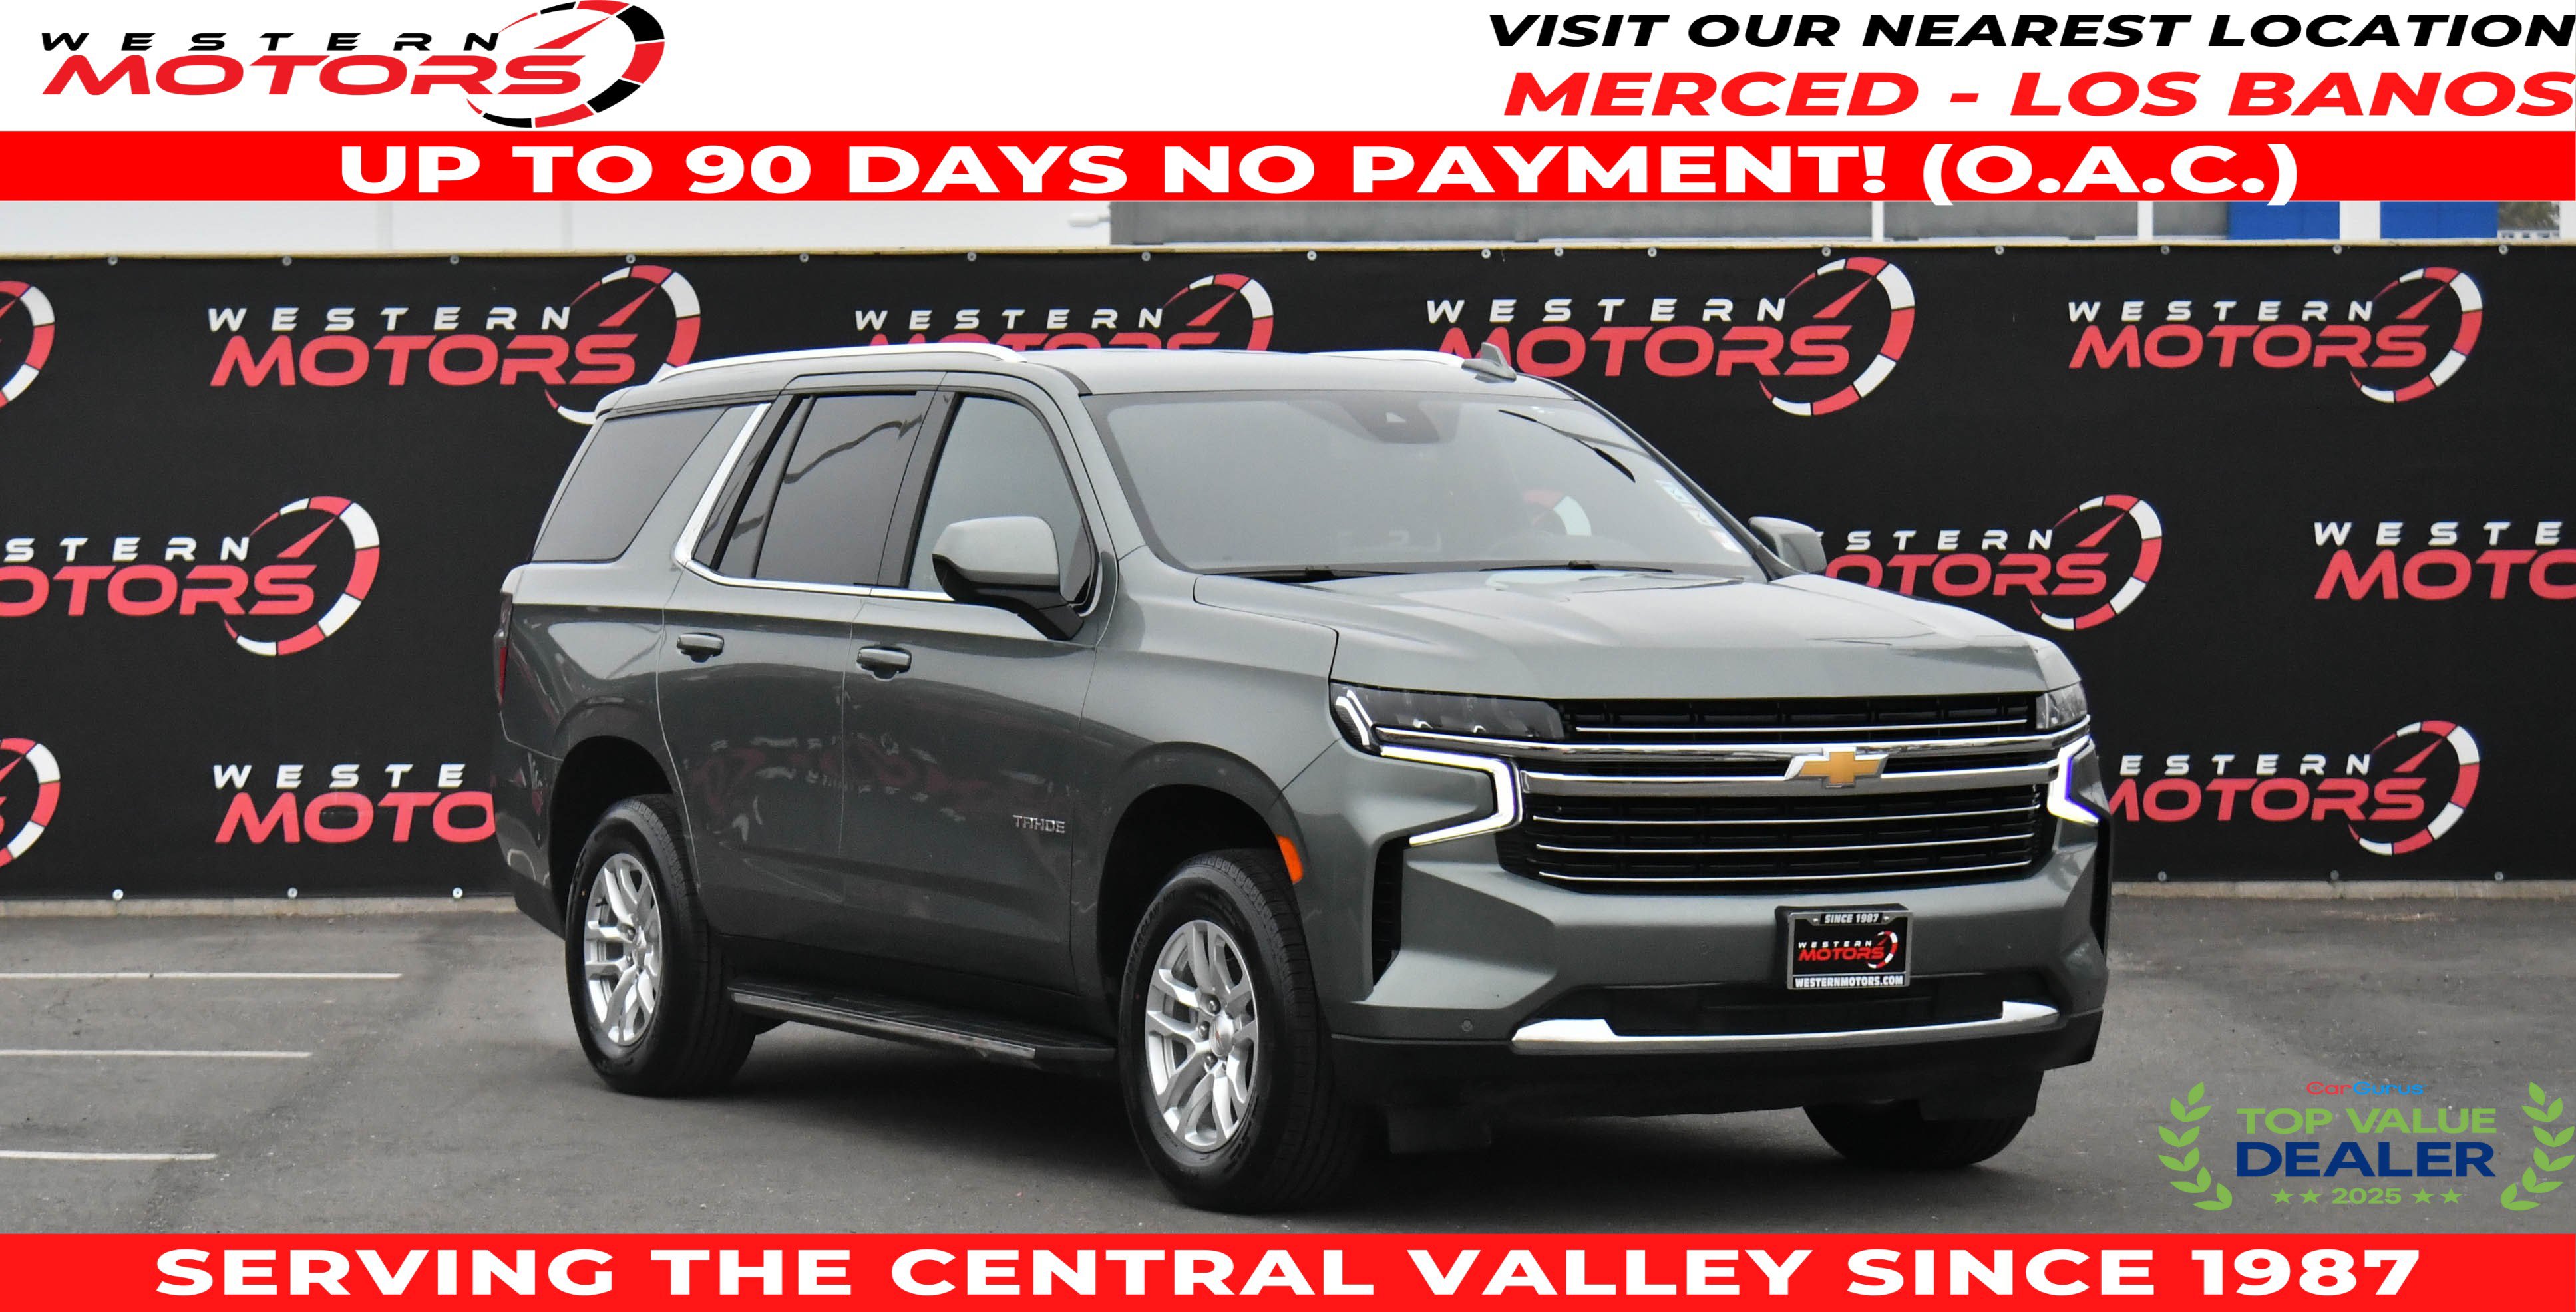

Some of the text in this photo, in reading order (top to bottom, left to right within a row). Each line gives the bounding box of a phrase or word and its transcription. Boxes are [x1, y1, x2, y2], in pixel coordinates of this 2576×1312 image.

[209, 307, 570, 331] WESTERN
[855, 308, 1163, 330] WESTERN
[1427, 298, 1785, 323] WESTERN
[2068, 301, 2373, 322] WESTERN
[1439, 325, 1852, 377] MOTORS
[2069, 324, 2429, 369] MOTORS
[210, 334, 637, 387] MOTORS
[1816, 530, 2053, 551] STERN
[2314, 522, 2563, 546] WESTE
[3, 536, 250, 562] STERN
[1825, 553, 2109, 597] OTORS
[2315, 549, 2576, 600] MOTO
[0, 564, 317, 617] OTORS
[214, 764, 466, 789] WESTE
[2119, 754, 2370, 776] ESTERN
[215, 791, 496, 843] MOTO
[1012, 814, 1065, 834] TAHOE
[1824, 913, 1880, 924] SINCE 1987
[1799, 947, 1885, 961] MOTORS
[1795, 975, 1904, 988] WESTERNMOTORS.COM
